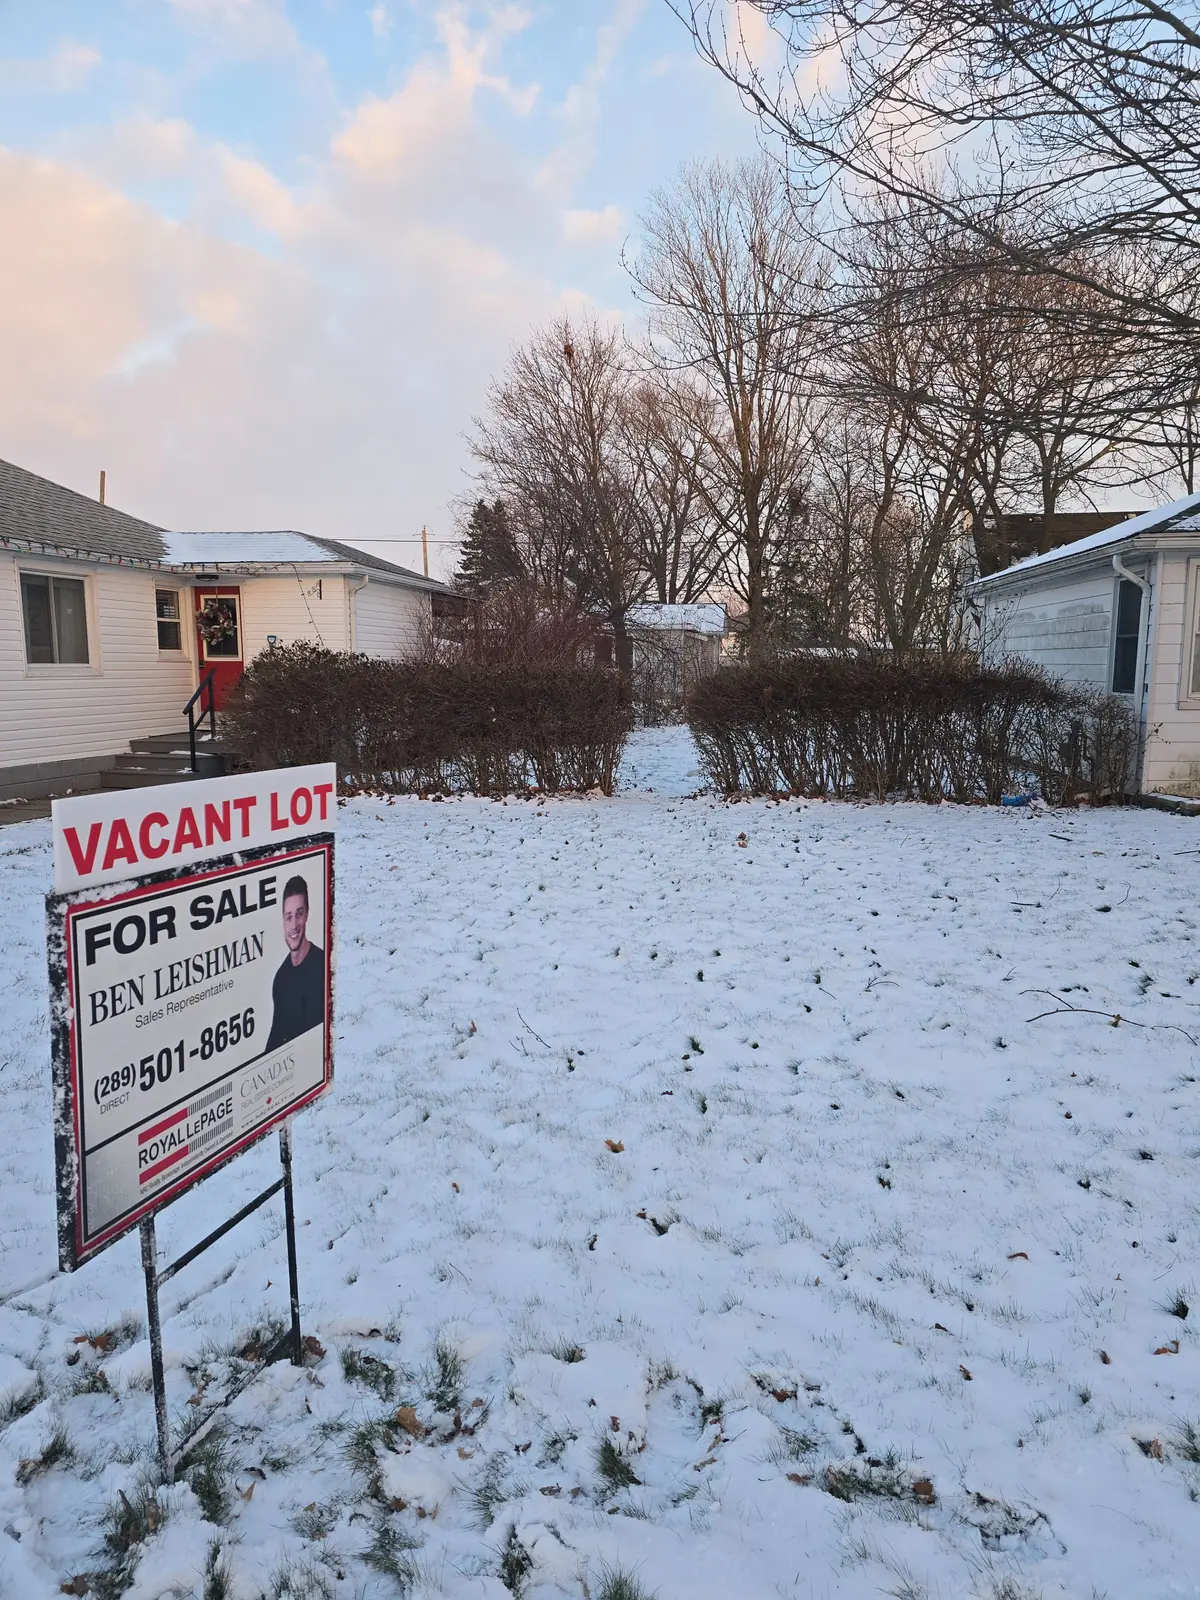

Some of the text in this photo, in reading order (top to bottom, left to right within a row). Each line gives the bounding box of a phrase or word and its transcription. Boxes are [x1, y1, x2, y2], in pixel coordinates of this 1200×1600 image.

[63, 783, 333, 876] VACANT LOT
[85, 876, 277, 966] FOR SALE
[88, 931, 265, 1026] BEN LEISHMAN
[135, 978, 235, 1029] Sales Representative
[100, 1091, 131, 1115] DIRECT
[138, 1128, 186, 1169] ROYAL
